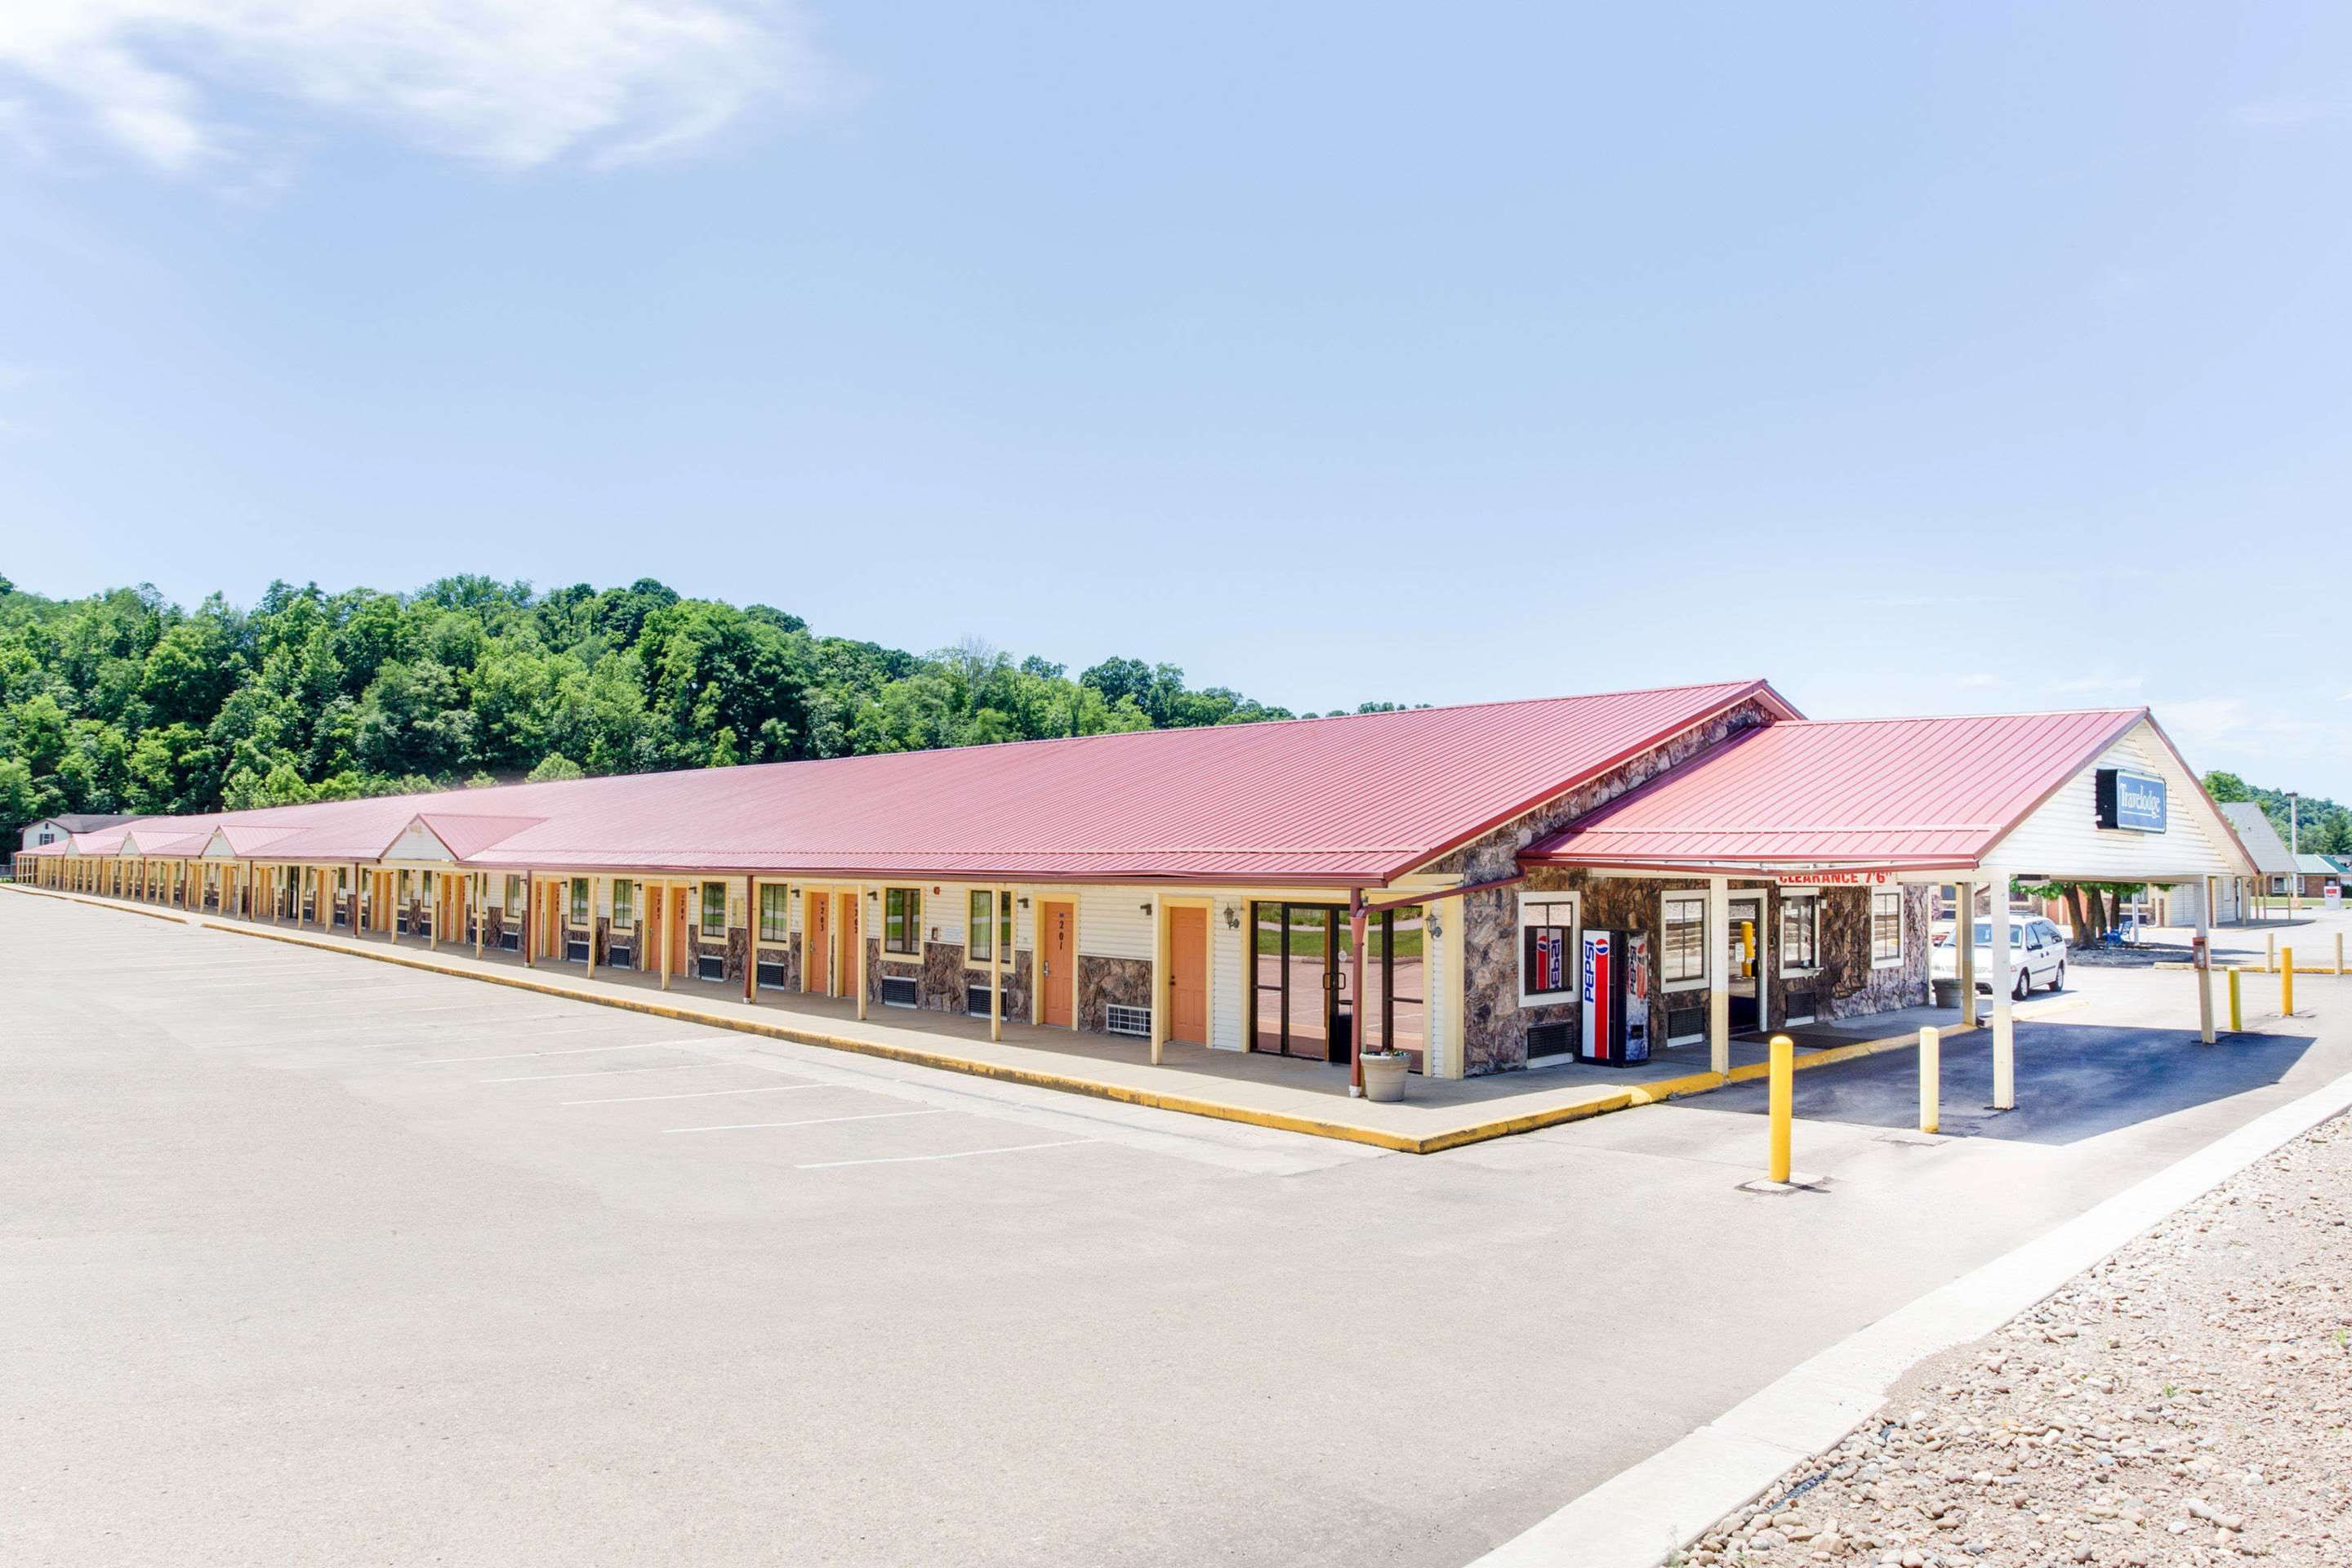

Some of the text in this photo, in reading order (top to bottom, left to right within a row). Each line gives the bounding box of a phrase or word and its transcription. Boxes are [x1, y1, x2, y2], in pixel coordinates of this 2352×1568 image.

[2120, 783, 2160, 819] Travelodge
[1780, 873, 1859, 884] CLEARANCE
[1584, 941, 1595, 1003] PEPSI
